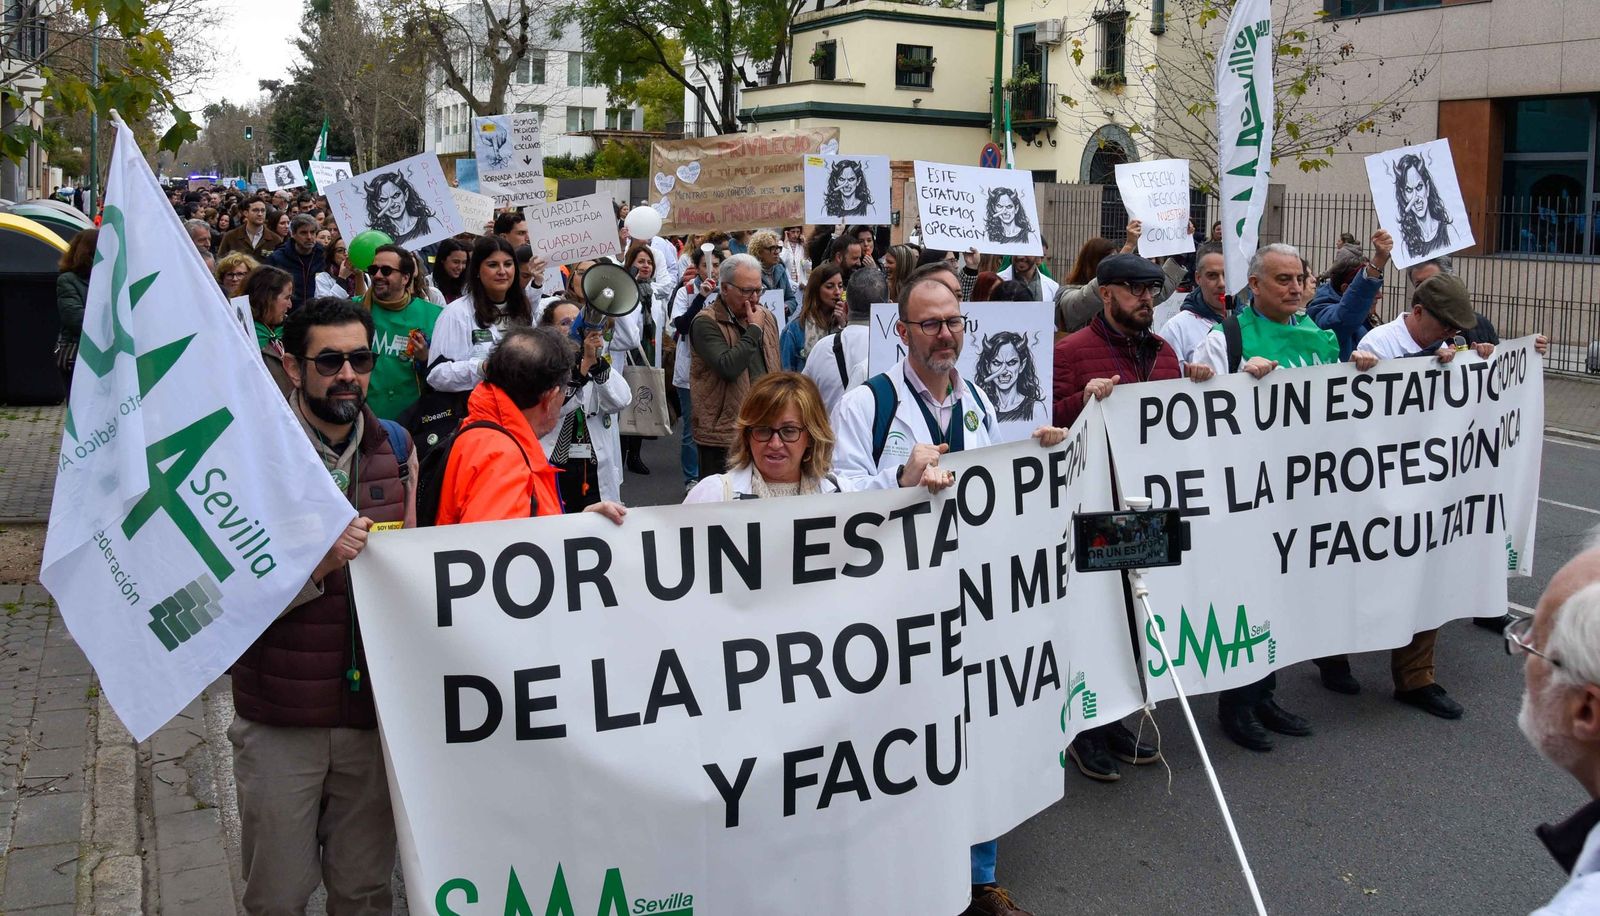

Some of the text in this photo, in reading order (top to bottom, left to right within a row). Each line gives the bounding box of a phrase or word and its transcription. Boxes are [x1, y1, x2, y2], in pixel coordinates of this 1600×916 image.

[513, 117, 538, 127] SOMOS
[482, 170, 542, 183] JORNADA LABORAL
[927, 166, 958, 184] ESTE
[1131, 170, 1175, 189] DERECHO
[780, 185, 791, 193] TU
[921, 185, 975, 204] ESTATUTO
[531, 199, 591, 223] GUARDIA
[547, 210, 603, 230] TRABAJADA
[928, 202, 976, 223] LEEMOS
[537, 230, 593, 253] GUARDIA
[550, 241, 616, 263] COTIZADA
[1139, 389, 1241, 445] POR
[1253, 380, 1311, 430] UN
[1144, 468, 1210, 518] DE
[1224, 461, 1274, 514] LA
[1286, 418, 1500, 501] PROFESIÓN
[189, 467, 278, 580] Sevilla
[1272, 528, 1298, 575] Y
[433, 535, 620, 628] POR
[642, 521, 762, 602] UN
[443, 663, 568, 744] DE
[591, 648, 703, 732] LA
[703, 756, 758, 829] Y
[632, 891, 694, 915] Sevilla
